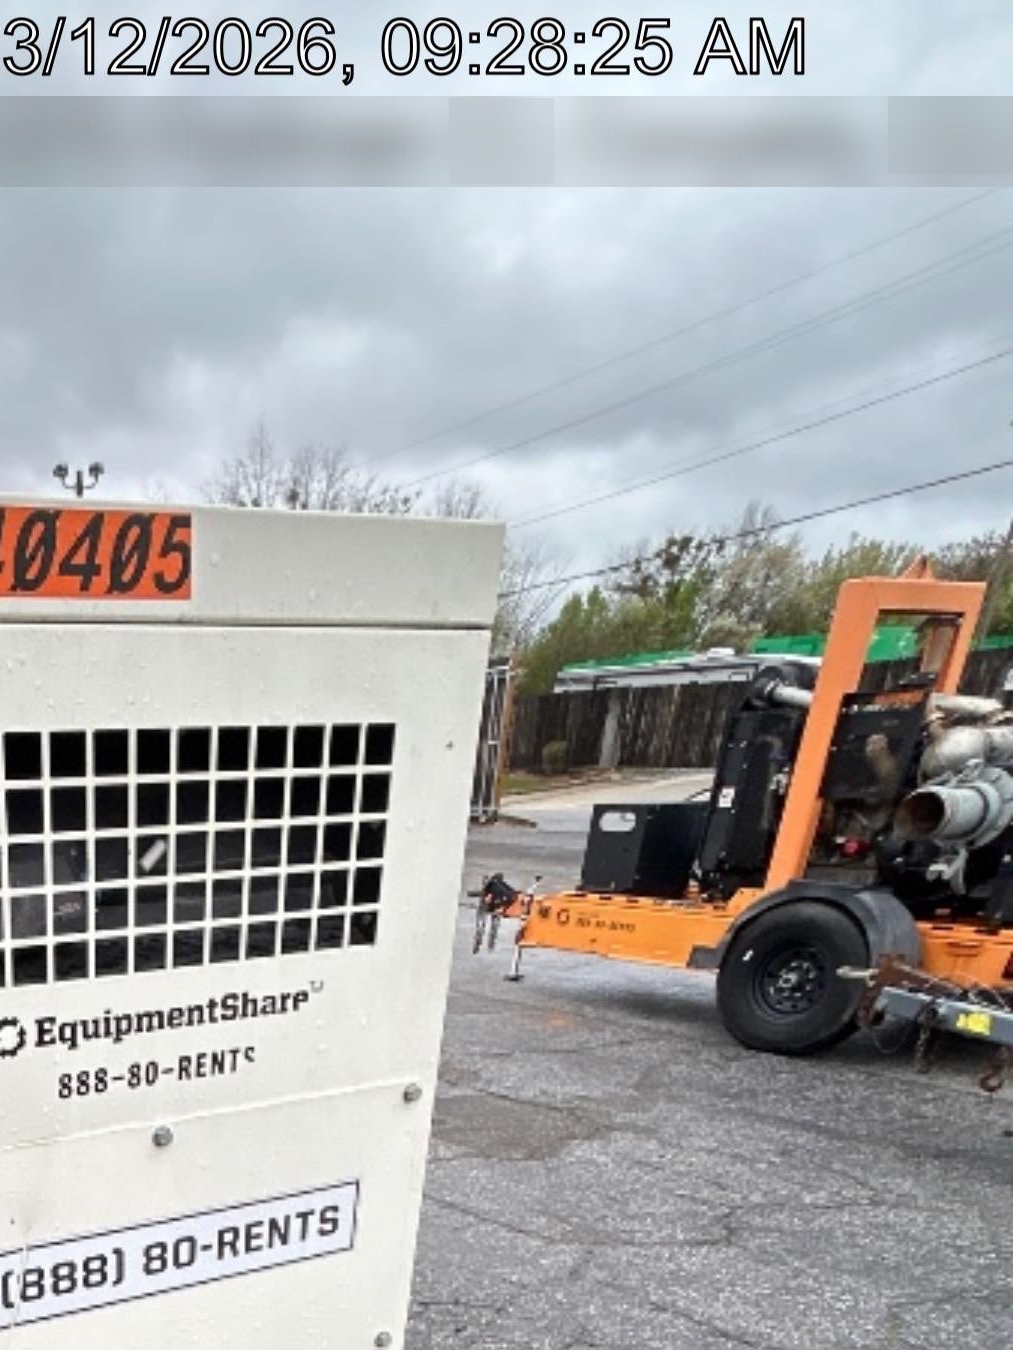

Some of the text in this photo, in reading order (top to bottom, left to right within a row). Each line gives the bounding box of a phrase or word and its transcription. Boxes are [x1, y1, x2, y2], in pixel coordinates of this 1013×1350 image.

[34, 988, 309, 1050] EquipmentShare
[0, 1204, 340, 1309] (888) 80-RENTS
